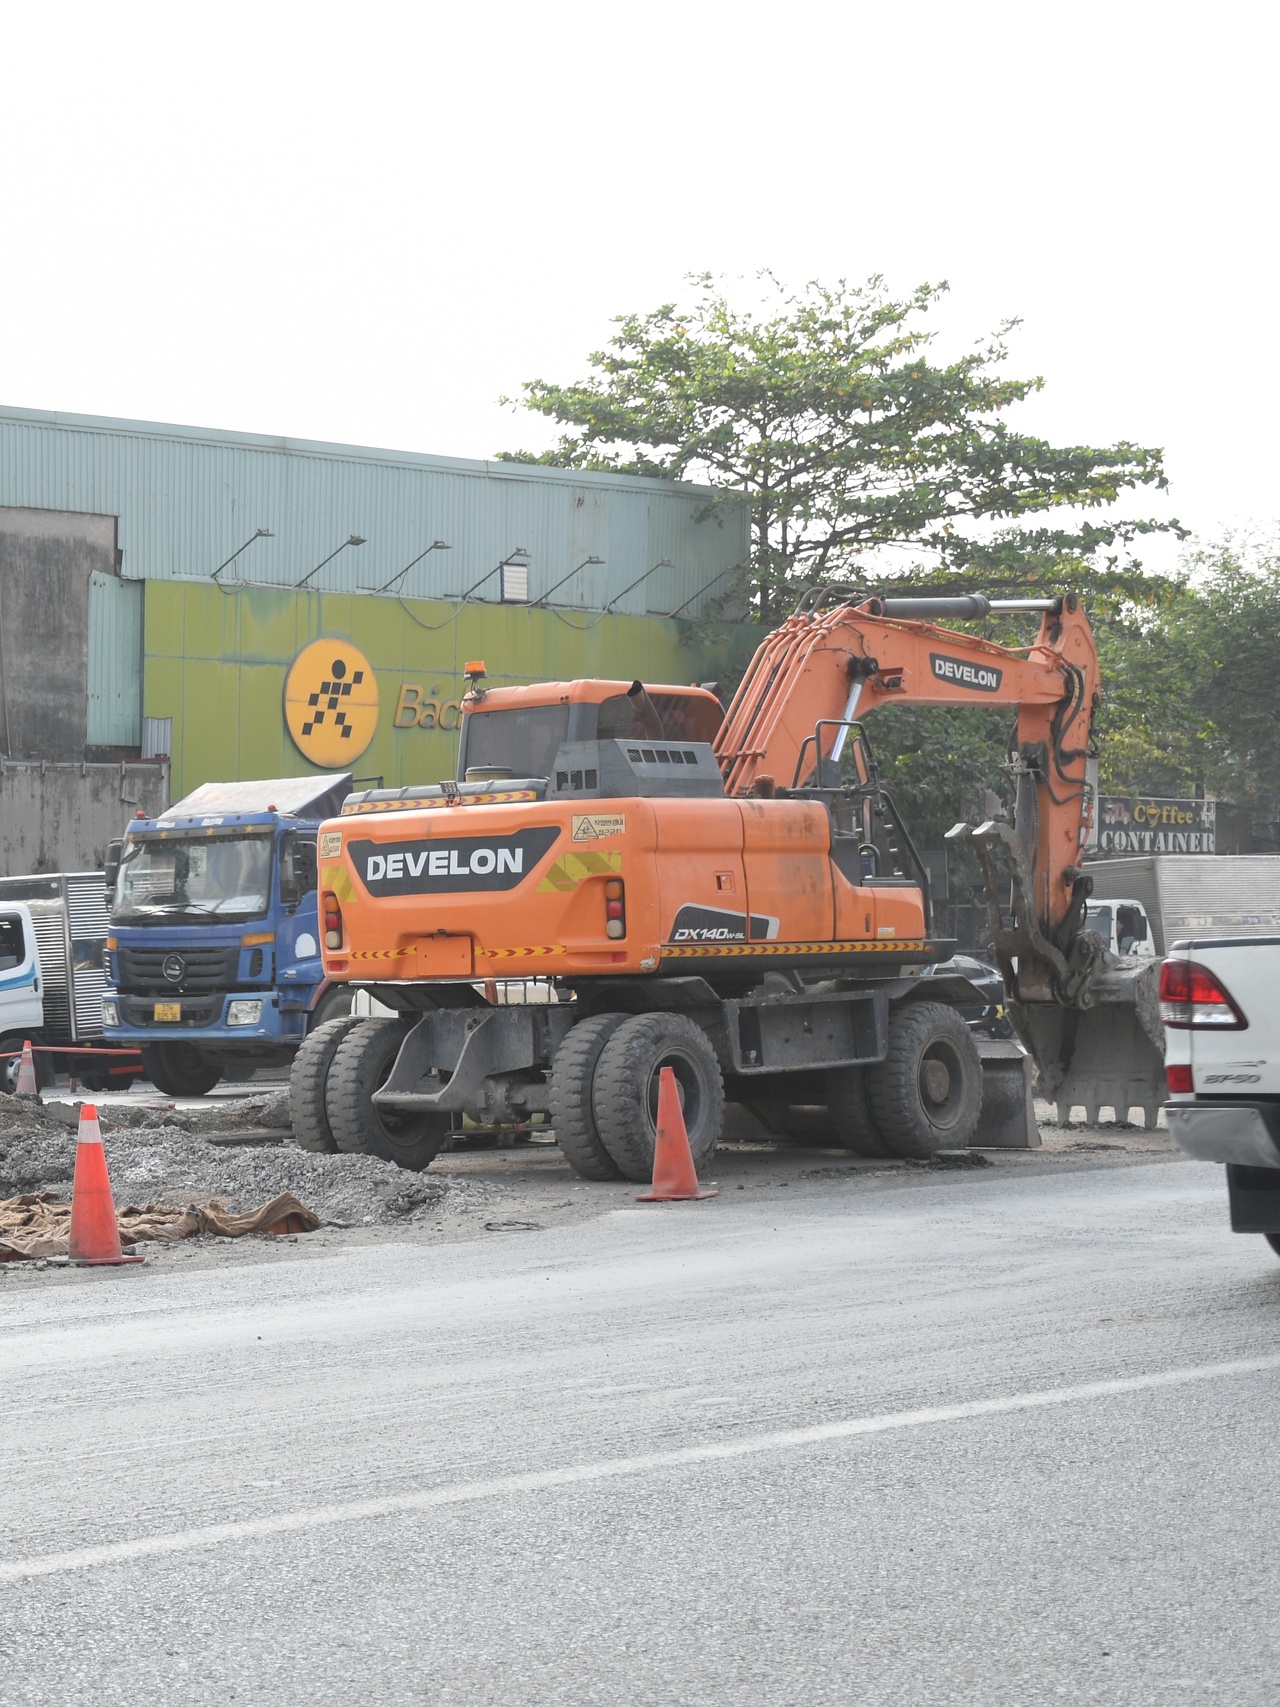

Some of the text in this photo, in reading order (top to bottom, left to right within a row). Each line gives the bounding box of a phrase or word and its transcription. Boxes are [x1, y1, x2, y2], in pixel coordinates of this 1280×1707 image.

[935, 659, 997, 688] DEVELON
[1101, 830, 1215, 852] CONTAINER
[367, 847, 523, 881] DEVELON
